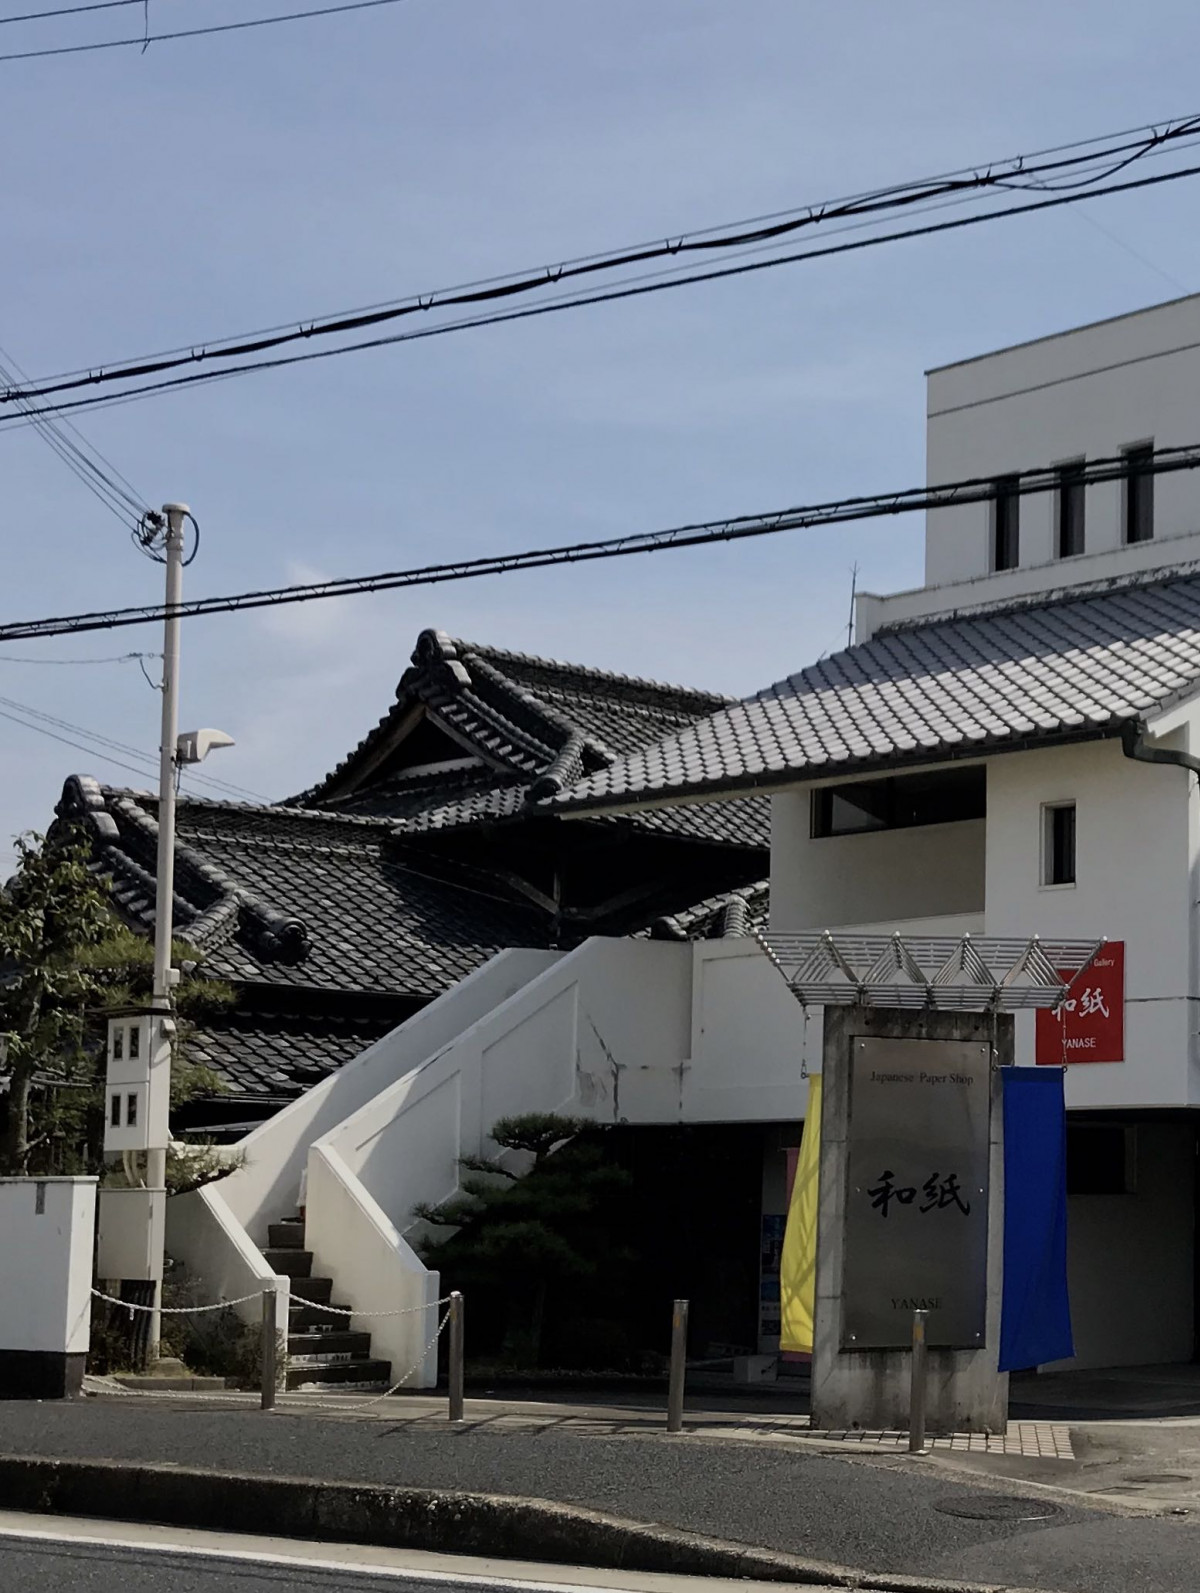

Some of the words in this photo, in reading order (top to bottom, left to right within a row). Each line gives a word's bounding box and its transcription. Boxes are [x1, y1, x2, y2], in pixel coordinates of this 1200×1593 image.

[1093, 958, 1115, 967] Gallery
[1062, 1037, 1096, 1048] YANASE
[870, 1071, 914, 1084] Japanese
[920, 1072, 946, 1085] Paper
[949, 1073, 974, 1086] Shop
[867, 1170, 970, 1218] 和紙
[891, 1297, 942, 1309] YANASE
